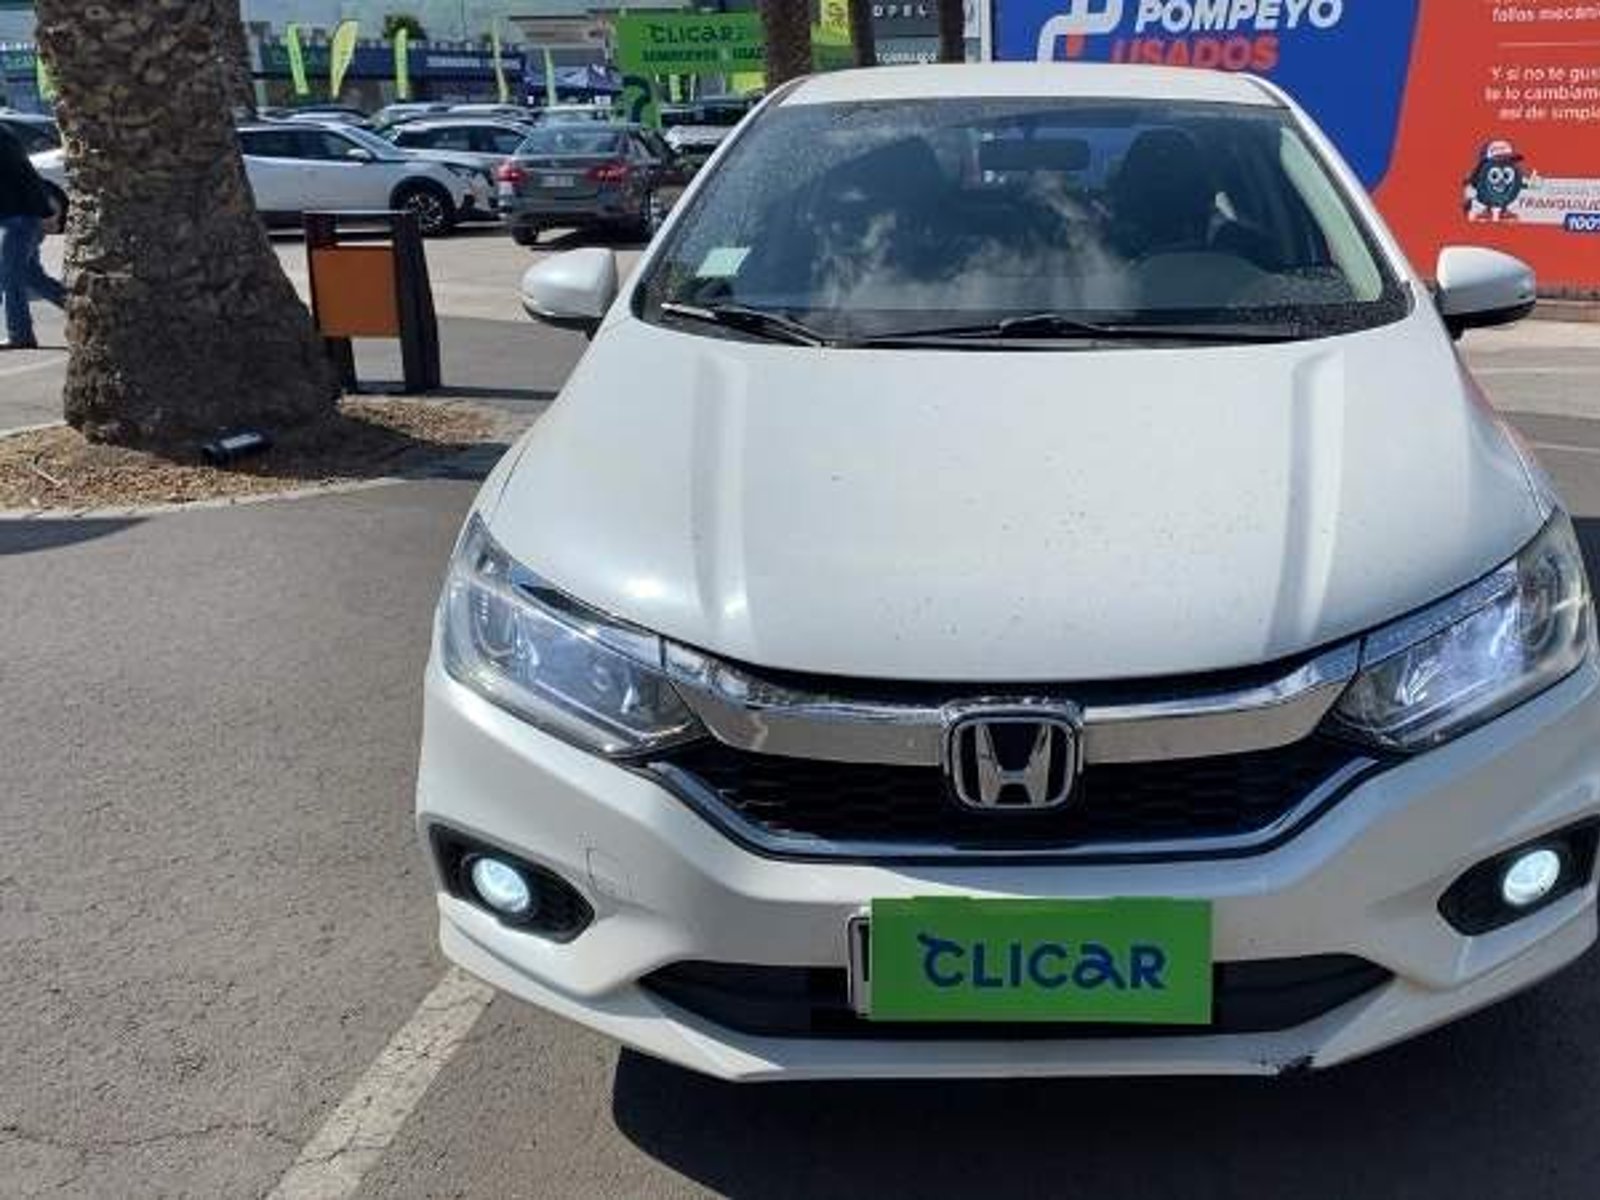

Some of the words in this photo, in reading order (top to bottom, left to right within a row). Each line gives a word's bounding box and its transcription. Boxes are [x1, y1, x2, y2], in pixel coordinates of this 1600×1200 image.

[1133, 0, 1344, 32] POMPEYO
[1110, 34, 1280, 71] USADOS
[1524, 68, 1545, 81] no
[1547, 66, 1565, 82] te
[1505, 85, 1520, 100] lo
